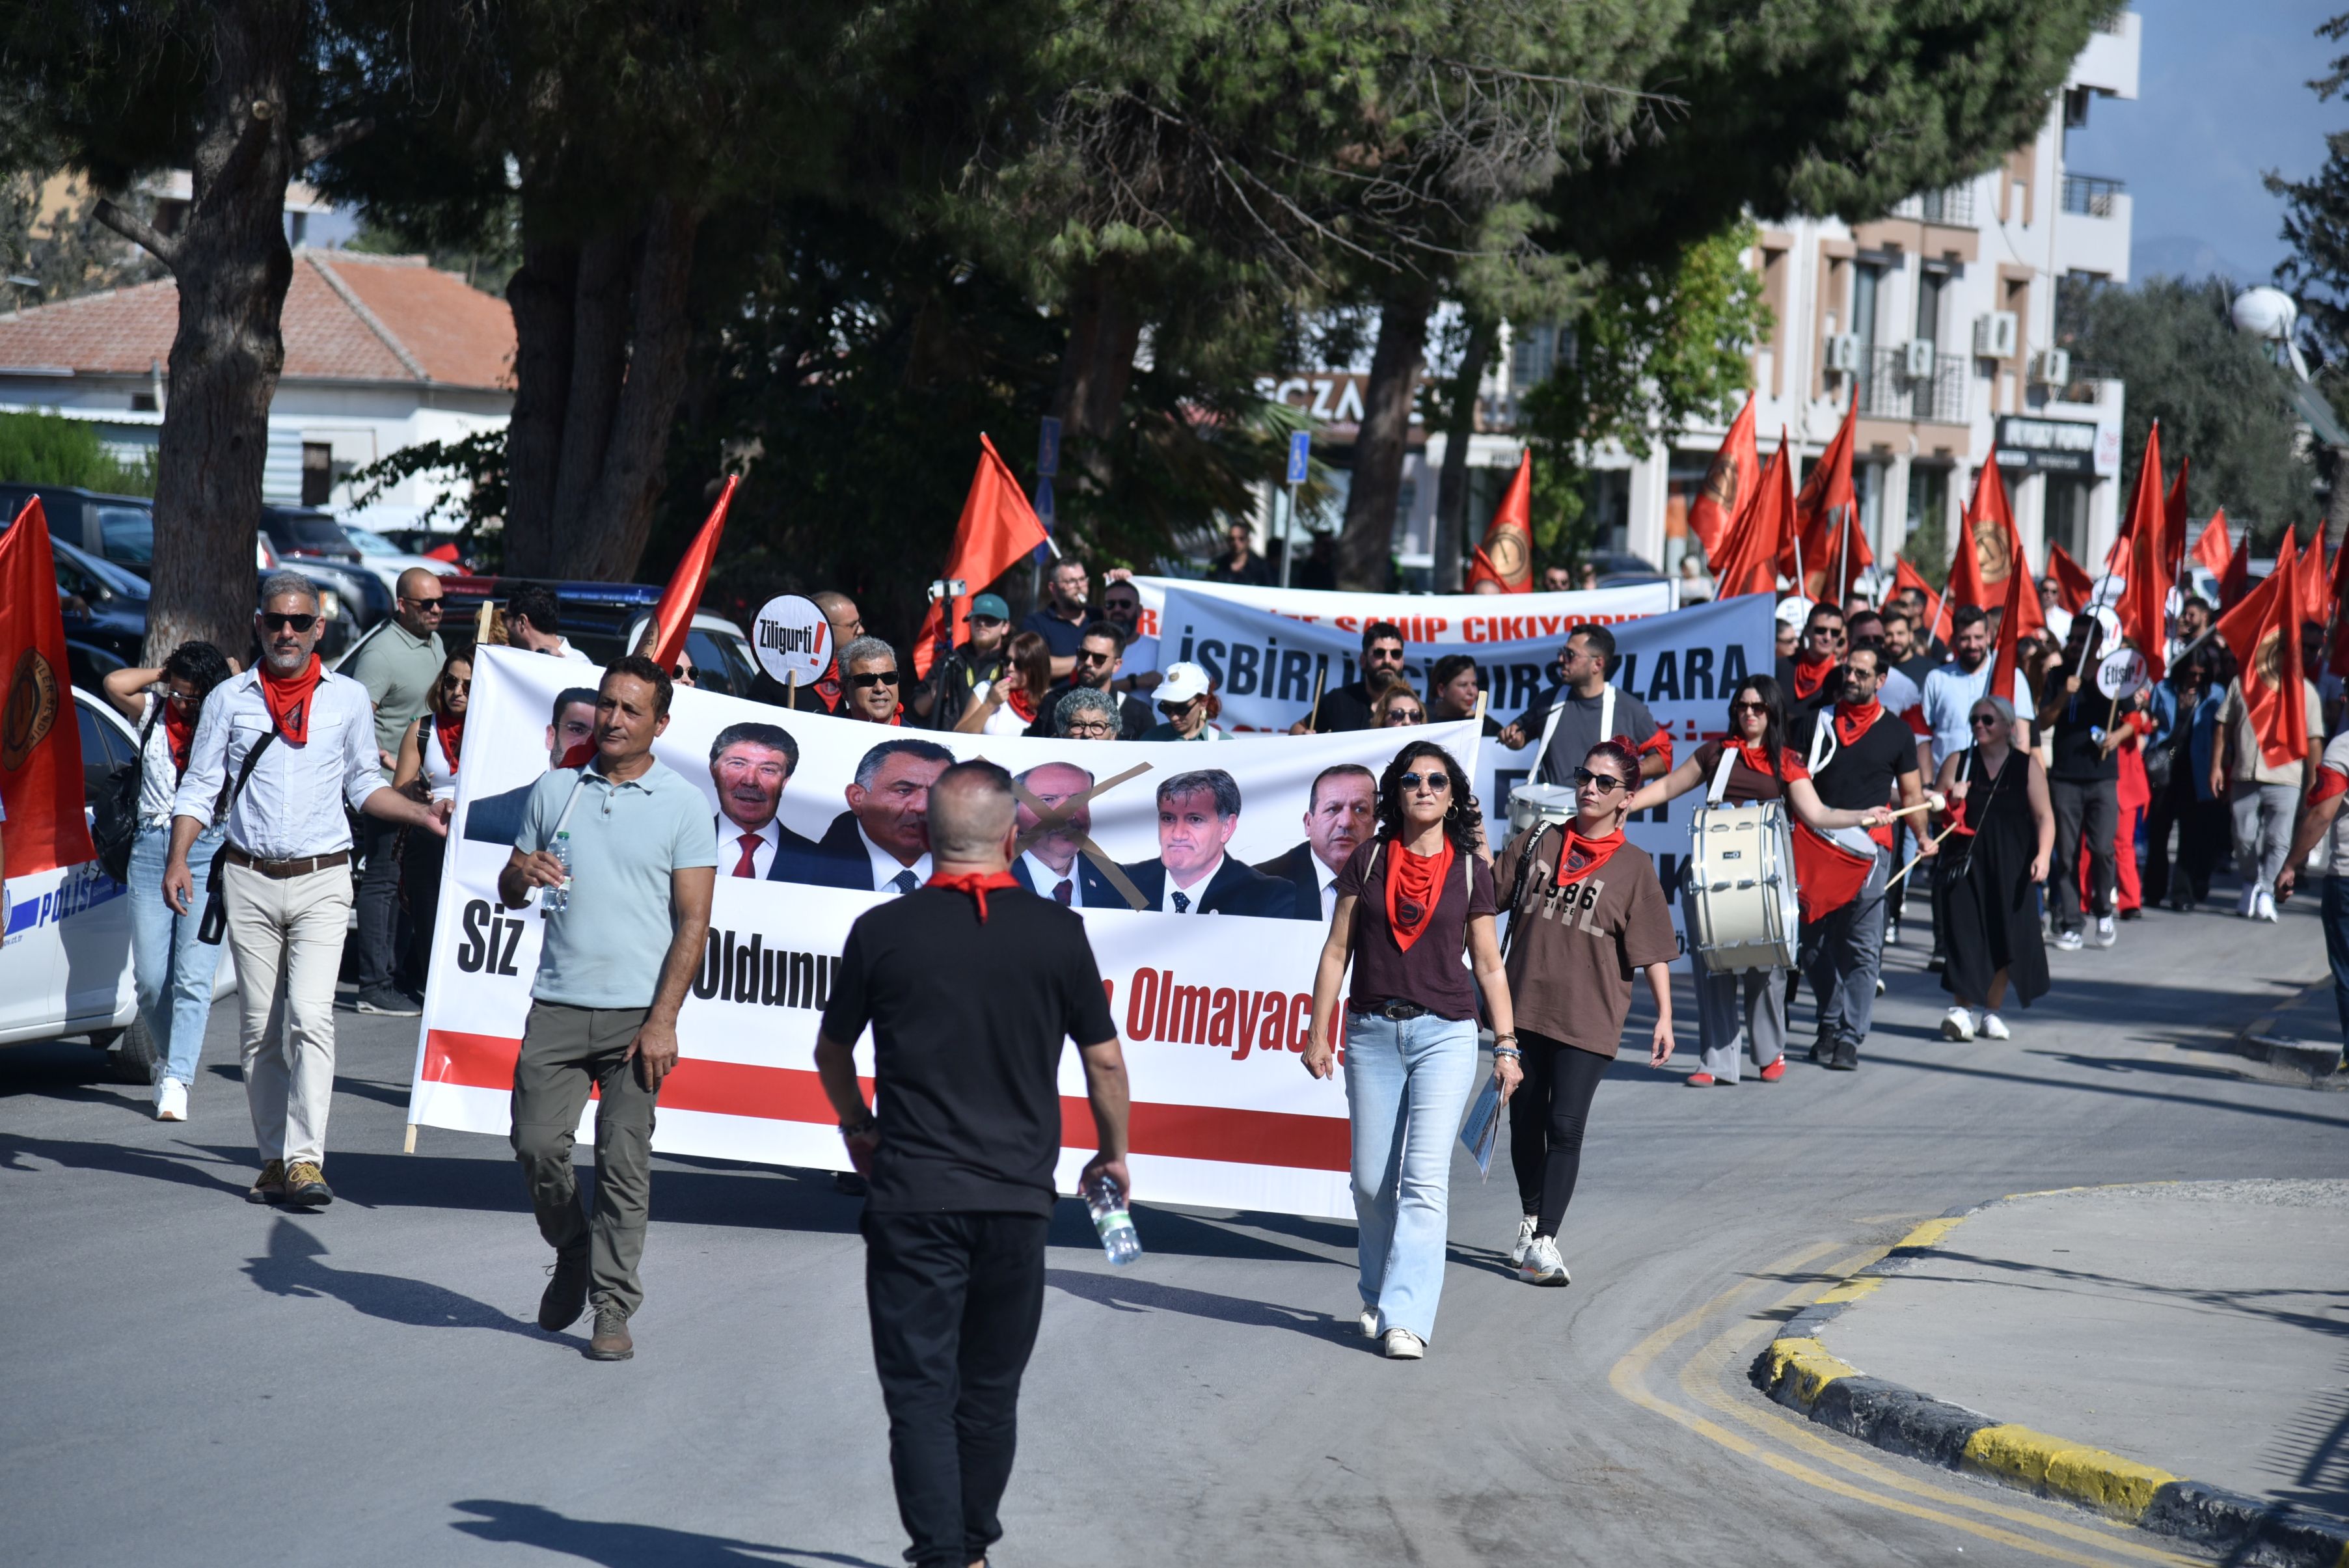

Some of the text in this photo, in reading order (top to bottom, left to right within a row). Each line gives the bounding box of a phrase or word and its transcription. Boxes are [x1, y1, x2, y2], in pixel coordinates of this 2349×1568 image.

[759, 619, 826, 666] Ziligurti!
[39, 872, 90, 928] POLİS
[1533, 871, 1597, 910] 1986
[1544, 900, 1575, 916] SINCE
[457, 899, 1346, 1067] Siz Oldunu Olmayac
